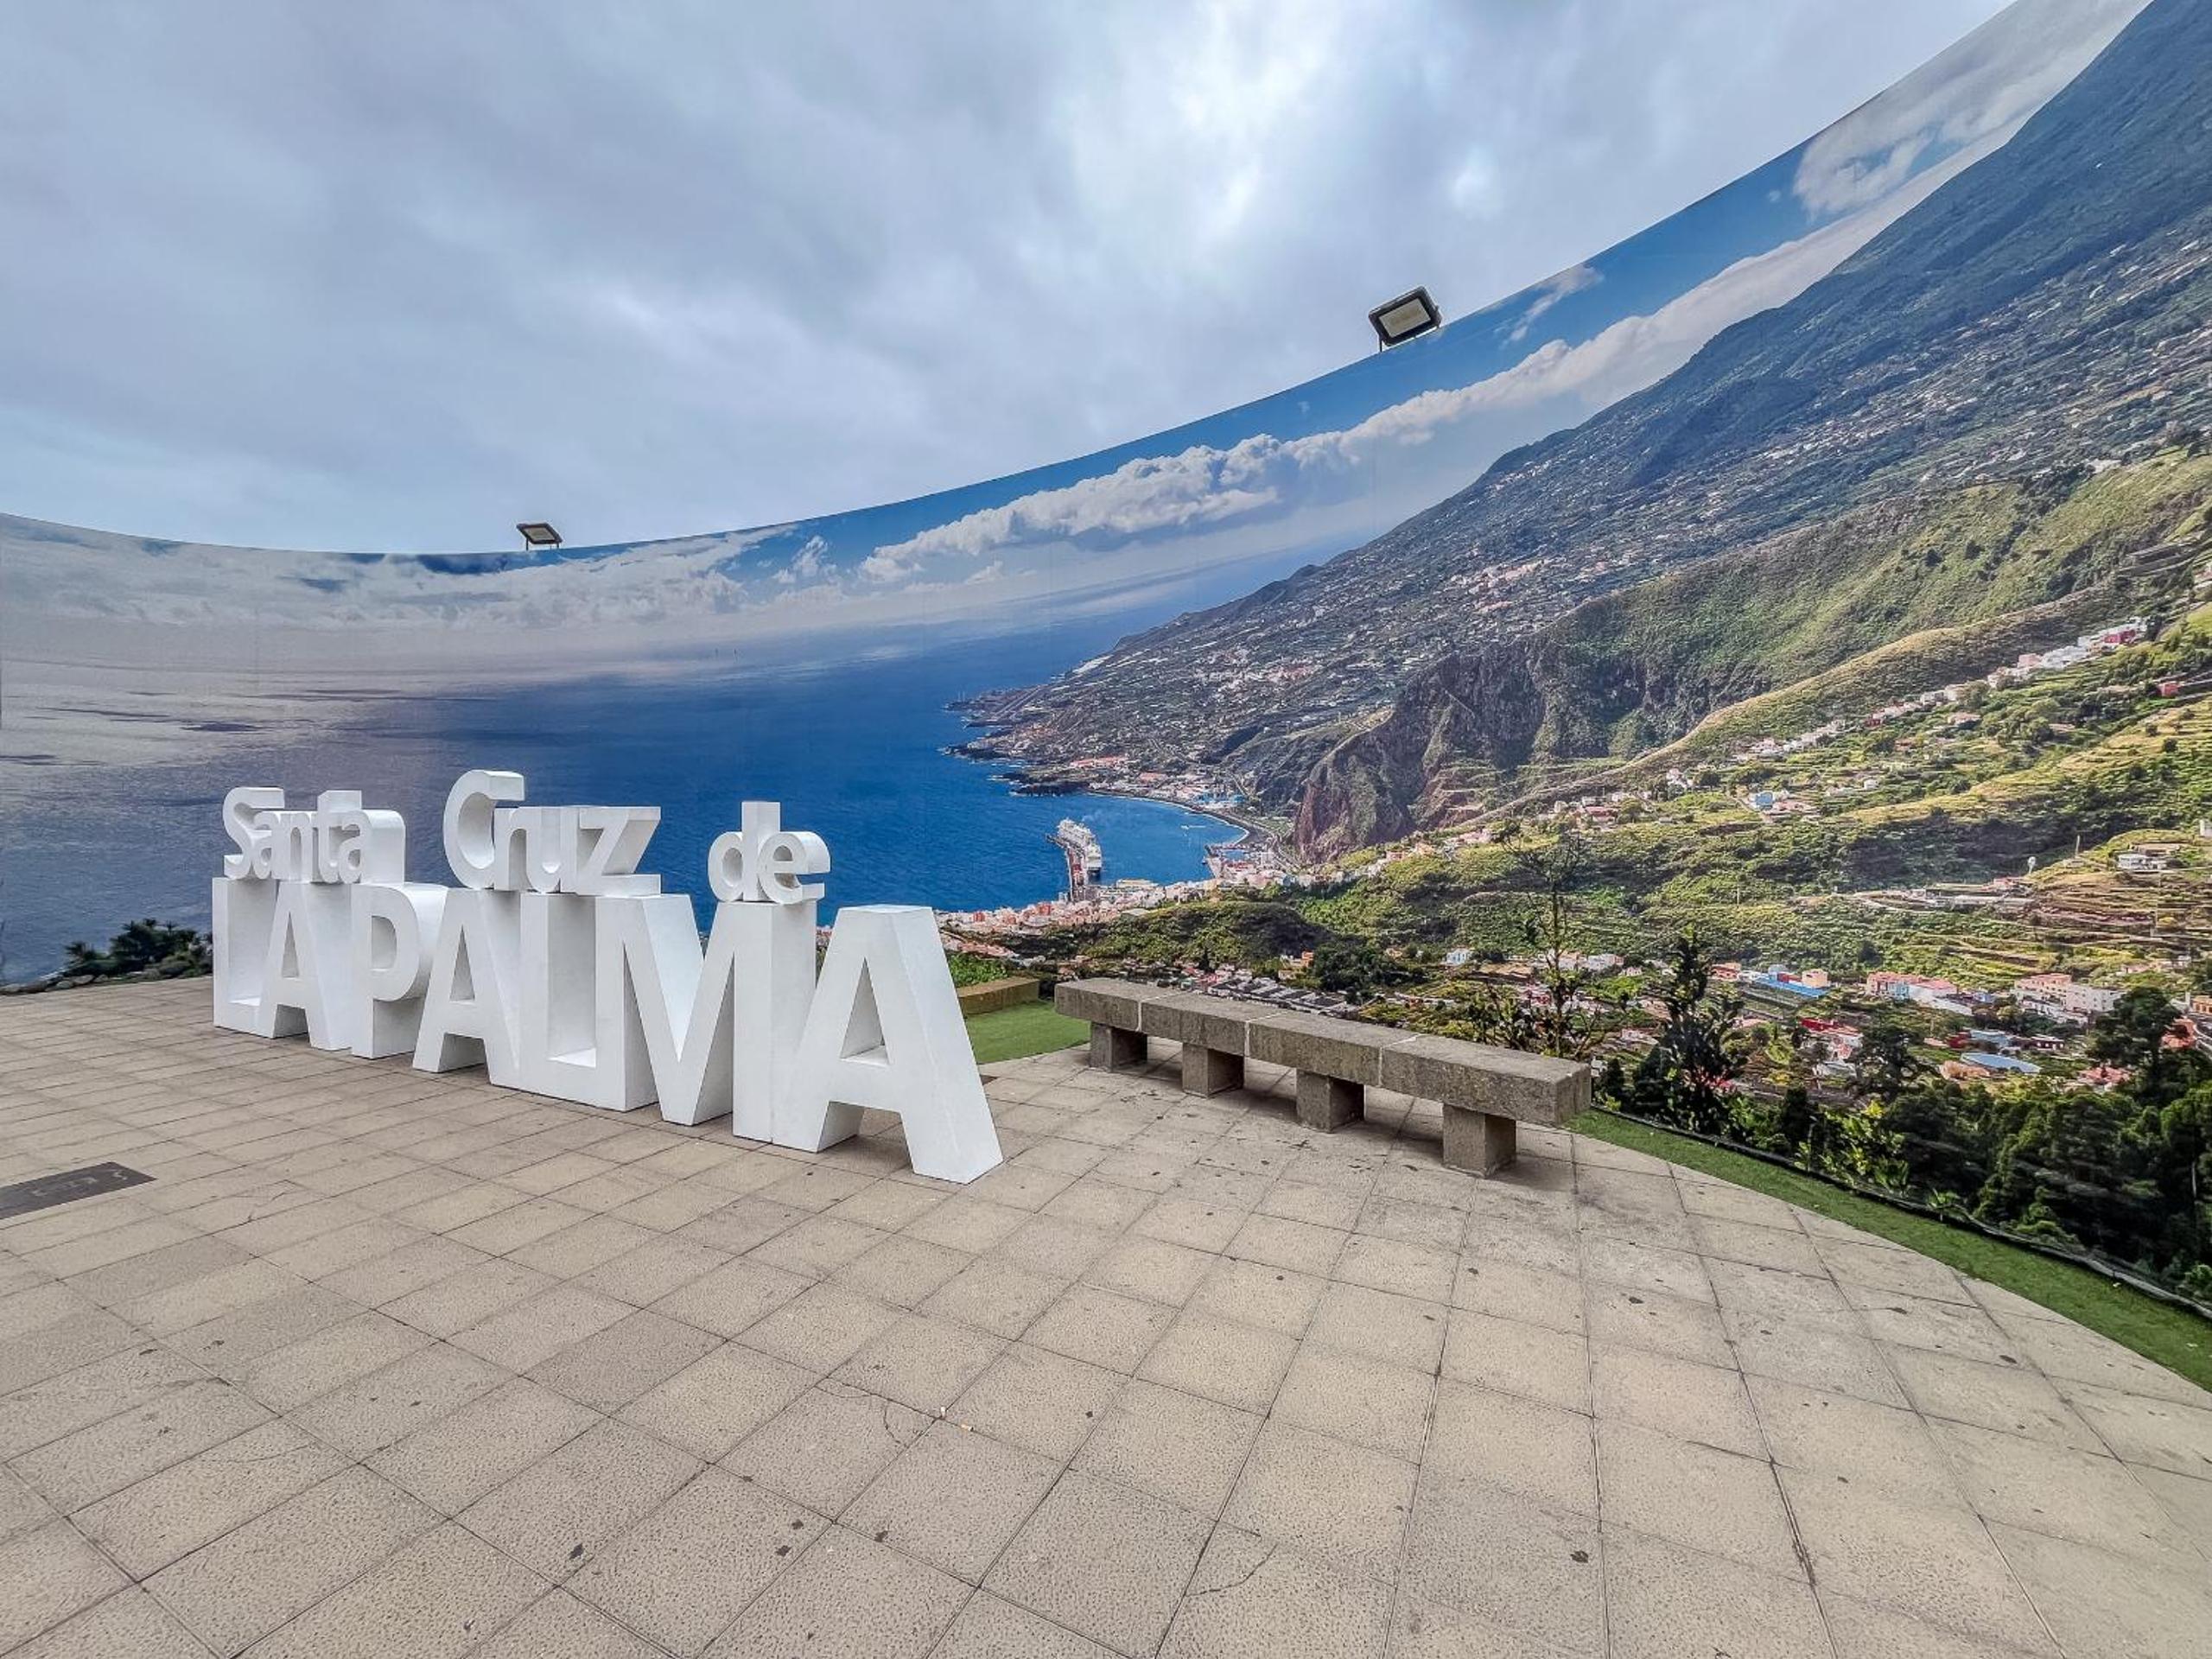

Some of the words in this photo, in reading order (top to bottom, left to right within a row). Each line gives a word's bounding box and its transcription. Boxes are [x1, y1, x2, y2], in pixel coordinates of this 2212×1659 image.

[222, 785, 405, 884] Santa
[443, 770, 661, 895] Cruz
[708, 801, 830, 904] de
[213, 877, 353, 1051] LA
[351, 883, 1003, 1185] PALMA
